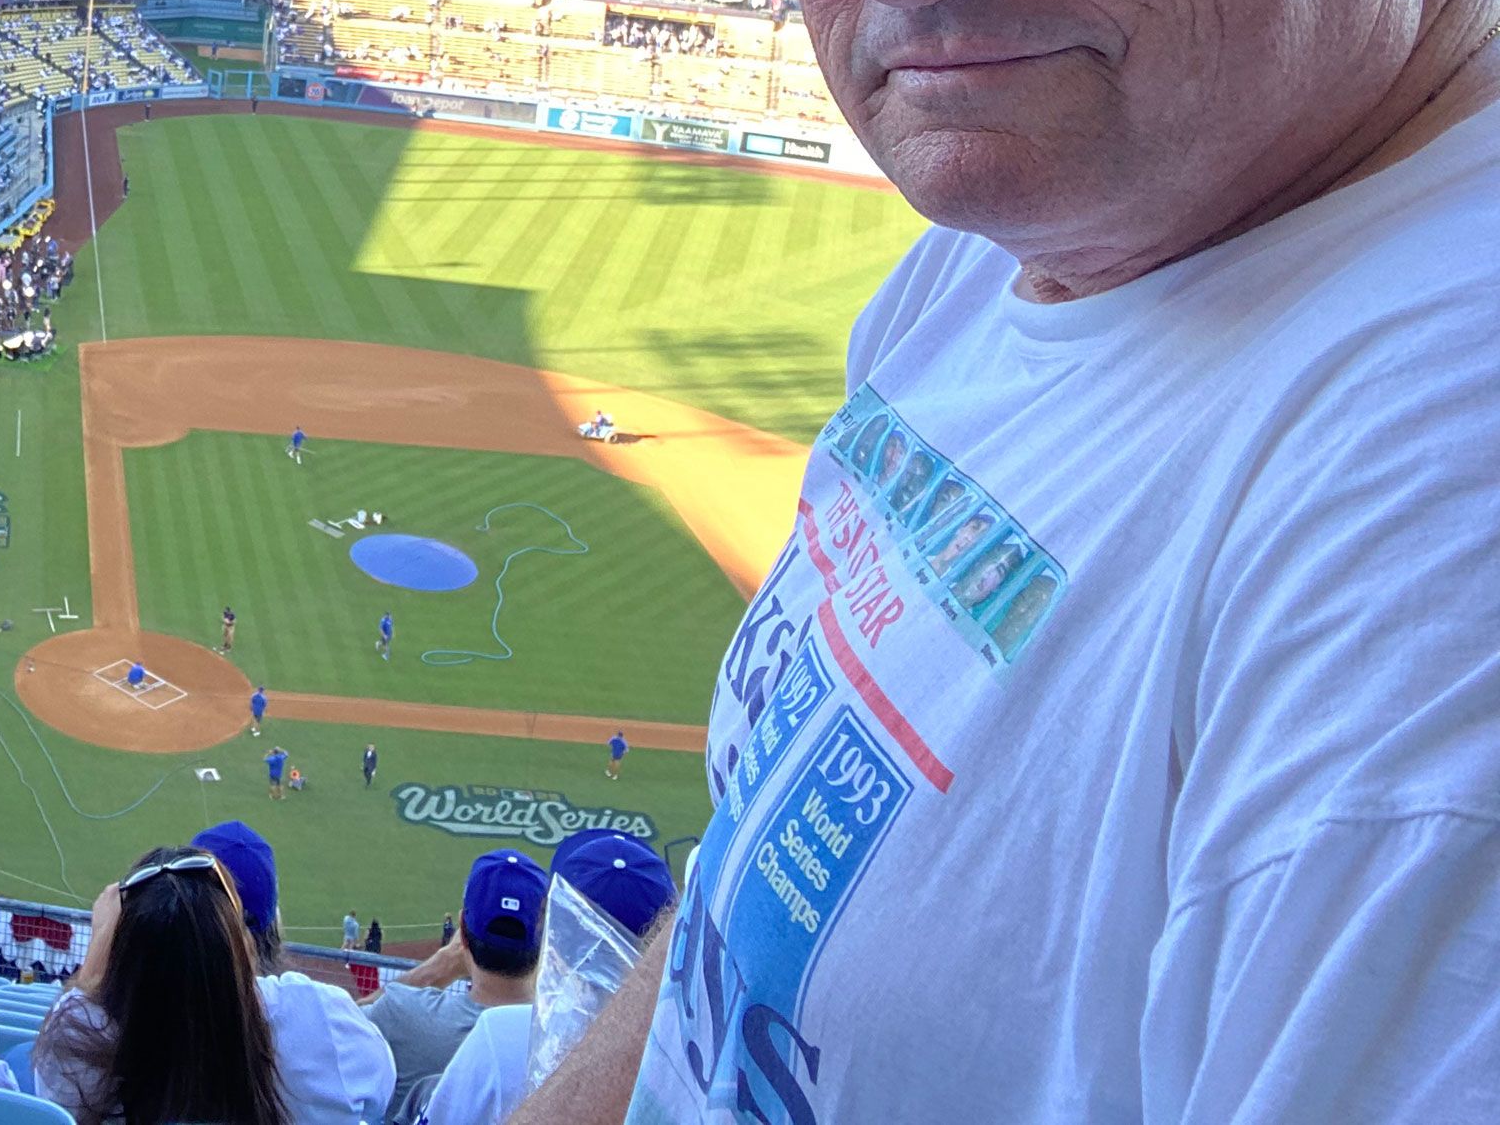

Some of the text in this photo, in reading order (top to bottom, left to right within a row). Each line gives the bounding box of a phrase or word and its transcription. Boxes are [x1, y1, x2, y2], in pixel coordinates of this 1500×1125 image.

[845, 565, 904, 649] STAR
[780, 657, 818, 727] 1992
[398, 786, 652, 844] World Series
[816, 732, 891, 825] 1993
[779, 818, 830, 892] Series
[801, 786, 854, 860] World
[756, 842, 821, 933] Champs
